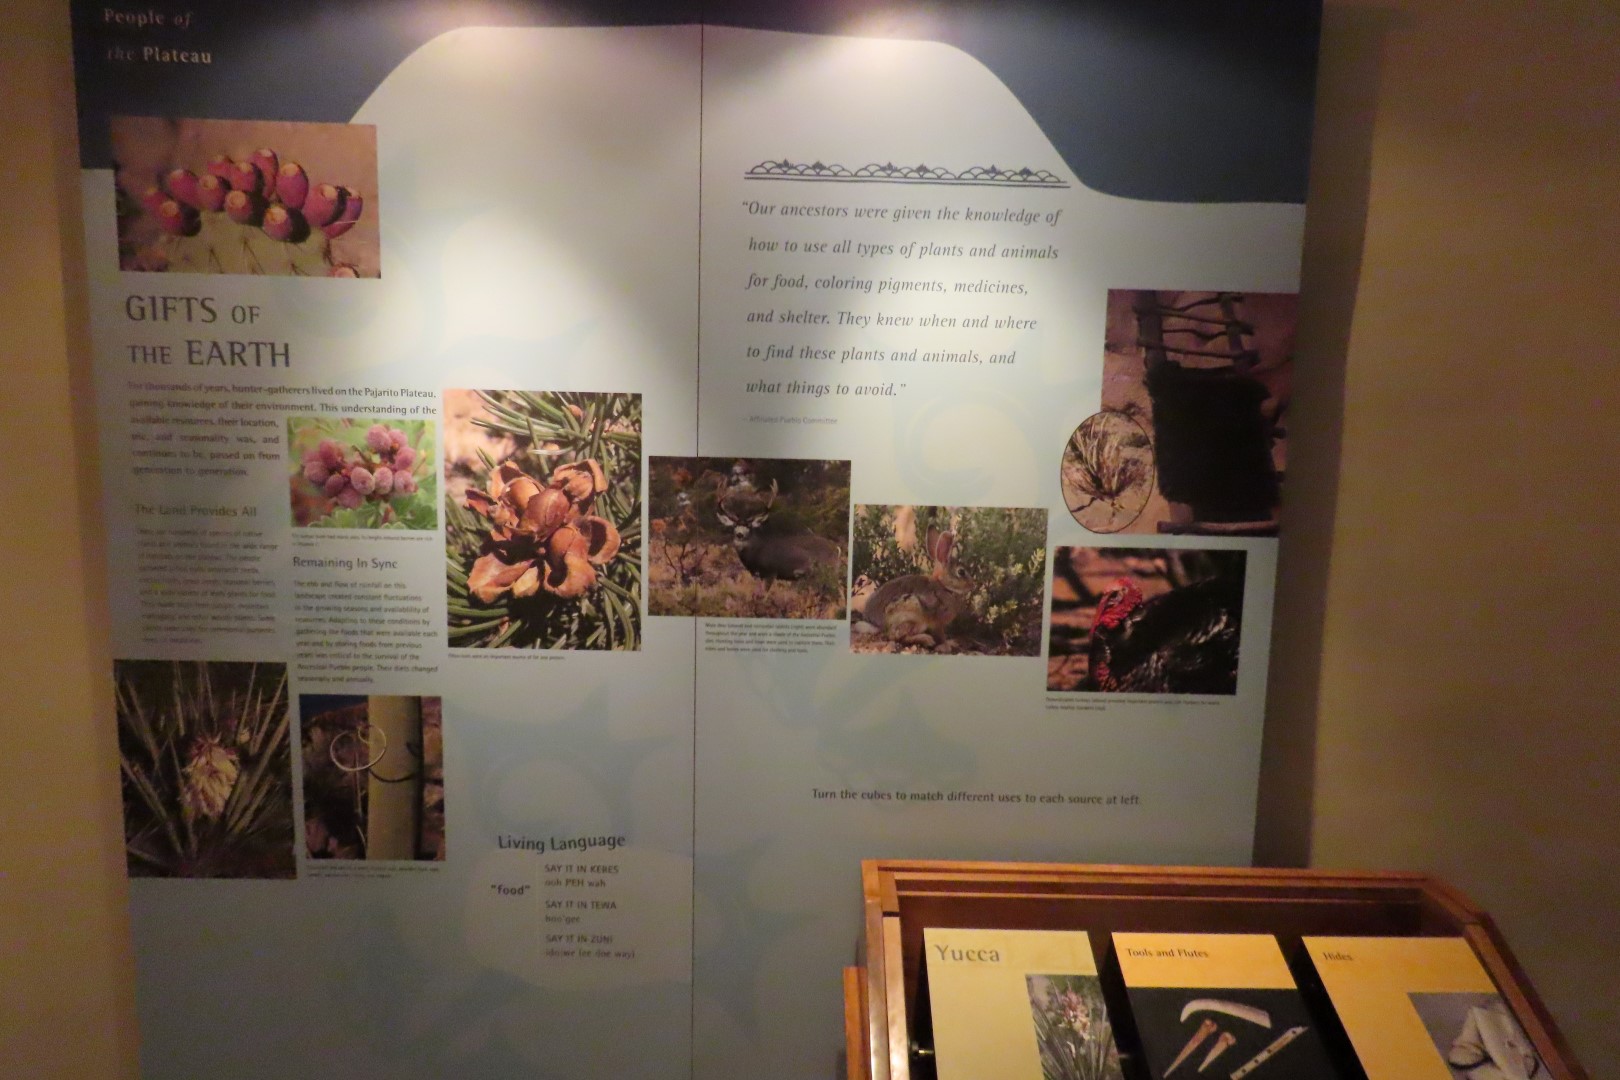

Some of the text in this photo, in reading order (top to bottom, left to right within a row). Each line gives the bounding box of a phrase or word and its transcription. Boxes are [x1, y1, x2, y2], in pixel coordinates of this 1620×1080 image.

[104, 8, 194, 29] People of
[107, 46, 211, 64] the Plateau
[742, 201, 1063, 227] "Our ancestors were given the knowledge of
[749, 236, 1059, 259] how to use all types of plants and animals
[745, 273, 1028, 296] for food, coloring pigments, medicines,
[126, 295, 260, 324] GIFTS OF
[747, 309, 1037, 329] and shelter. They knew when and where
[127, 340, 289, 367] THE EARTH
[747, 344, 1016, 365] to find these plants and animals, and
[746, 379, 906, 397] what things to avoid."
[167, 400, 216, 410] knowledge
[219, 401, 228, 409] of
[231, 401, 253, 410] their
[256, 402, 316, 412] environment.
[320, 403, 338, 412] This
[341, 404, 406, 415] understanding
[410, 406, 420, 414] of
[423, 406, 436, 414] the
[135, 504, 256, 516] The Land Provides All
[293, 556, 398, 571] Remaining In Sync
[812, 788, 836, 799] Turn
[840, 790, 857, 799] the
[861, 790, 891, 800] cubes
[896, 791, 906, 800] to
[910, 791, 943, 801] match
[947, 791, 994, 802] different
[999, 794, 1021, 802] uses
[1026, 794, 1036, 802] to
[1040, 793, 1064, 803] each
[1068, 795, 1102, 804] source
[1106, 795, 1116, 804] at
[498, 835, 626, 854] Living Language
[545, 864, 562, 873] SAY
[577, 865, 586, 873] IN
[591, 865, 619, 874] KERES
[491, 884, 530, 895] "food"
[545, 900, 562, 908] SAY
[591, 901, 616, 909] TEWA
[546, 934, 562, 943] SAY
[566, 935, 574, 943] IT
[578, 935, 587, 943] IN
[934, 944, 1000, 962] Yucca
[1128, 948, 1151, 957] Tools
[1178, 949, 1209, 958] Flutes
[1323, 952, 1354, 961] Hides
